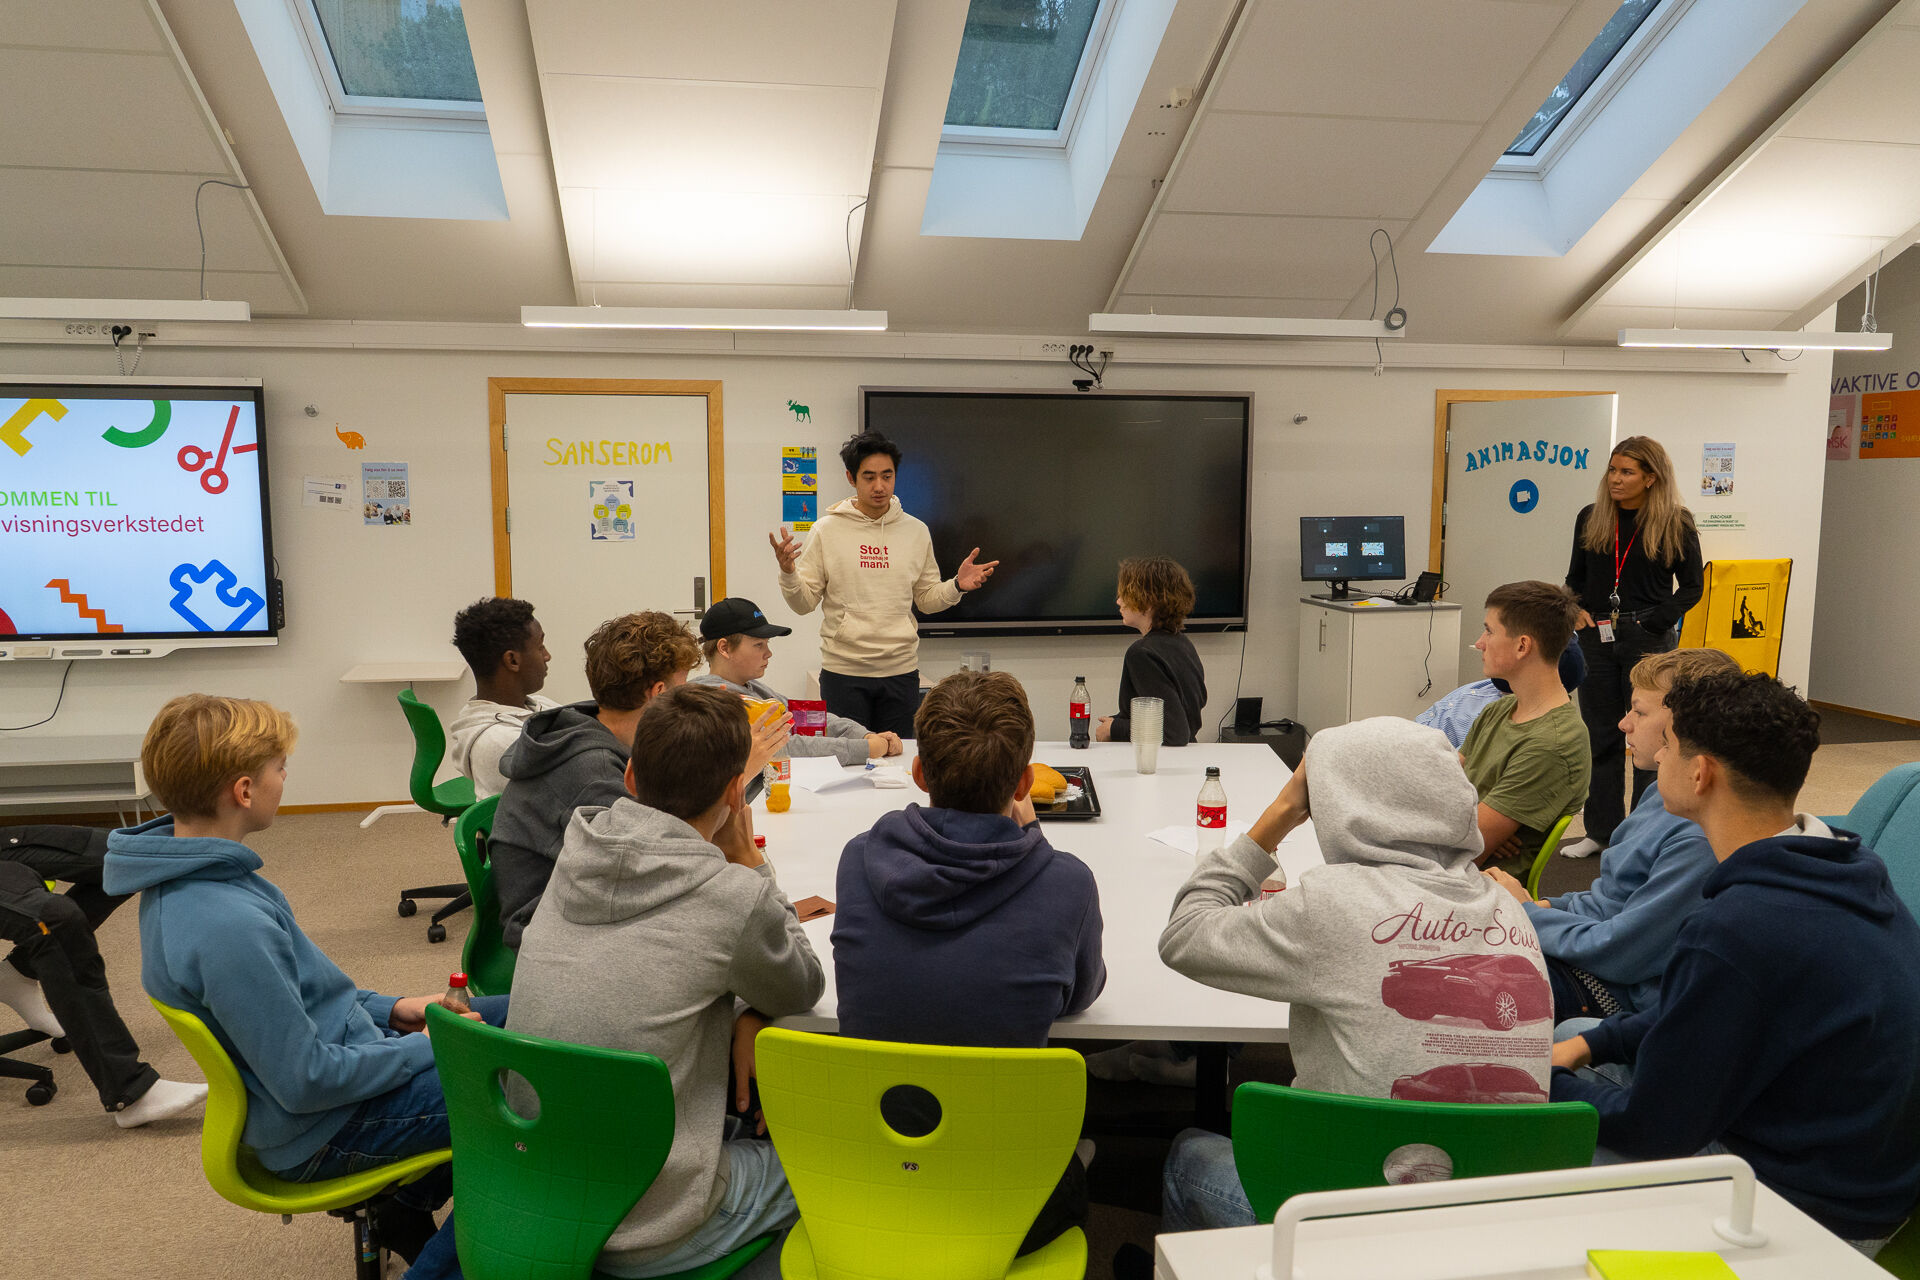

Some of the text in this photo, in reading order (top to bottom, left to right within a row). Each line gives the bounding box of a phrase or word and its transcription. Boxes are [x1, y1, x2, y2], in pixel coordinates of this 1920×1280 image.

[544, 438, 673, 466] SANSEROM
[1465, 439, 1590, 472] ANIMASJON
[85, 491, 118, 506] TIL
[2, 514, 204, 537] visningsverkstedet
[860, 544, 888, 555] Stot
[1371, 902, 1541, 952] Auto-Serie
[904, 1162, 916, 1171] VS
